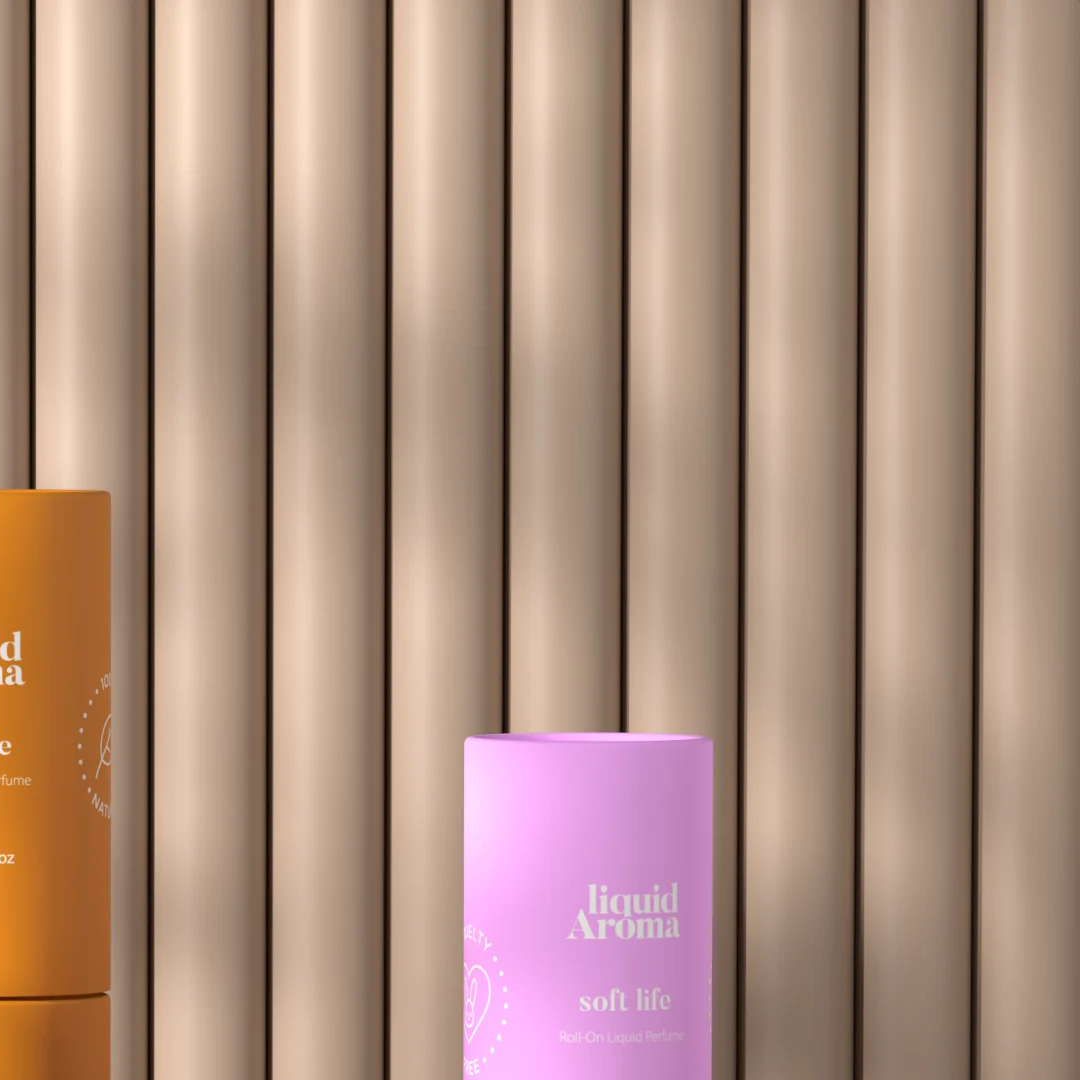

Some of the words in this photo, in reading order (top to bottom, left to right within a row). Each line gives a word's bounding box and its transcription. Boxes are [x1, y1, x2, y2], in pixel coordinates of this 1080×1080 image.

[588, 882, 678, 917] liquid
[566, 908, 680, 940] Aroma
[579, 988, 628, 1012] soft
[636, 987, 671, 1011] life
[559, 1031, 604, 1044] Roll-On
[607, 1030, 642, 1046] Liquid
[645, 1030, 685, 1043] Perfume
